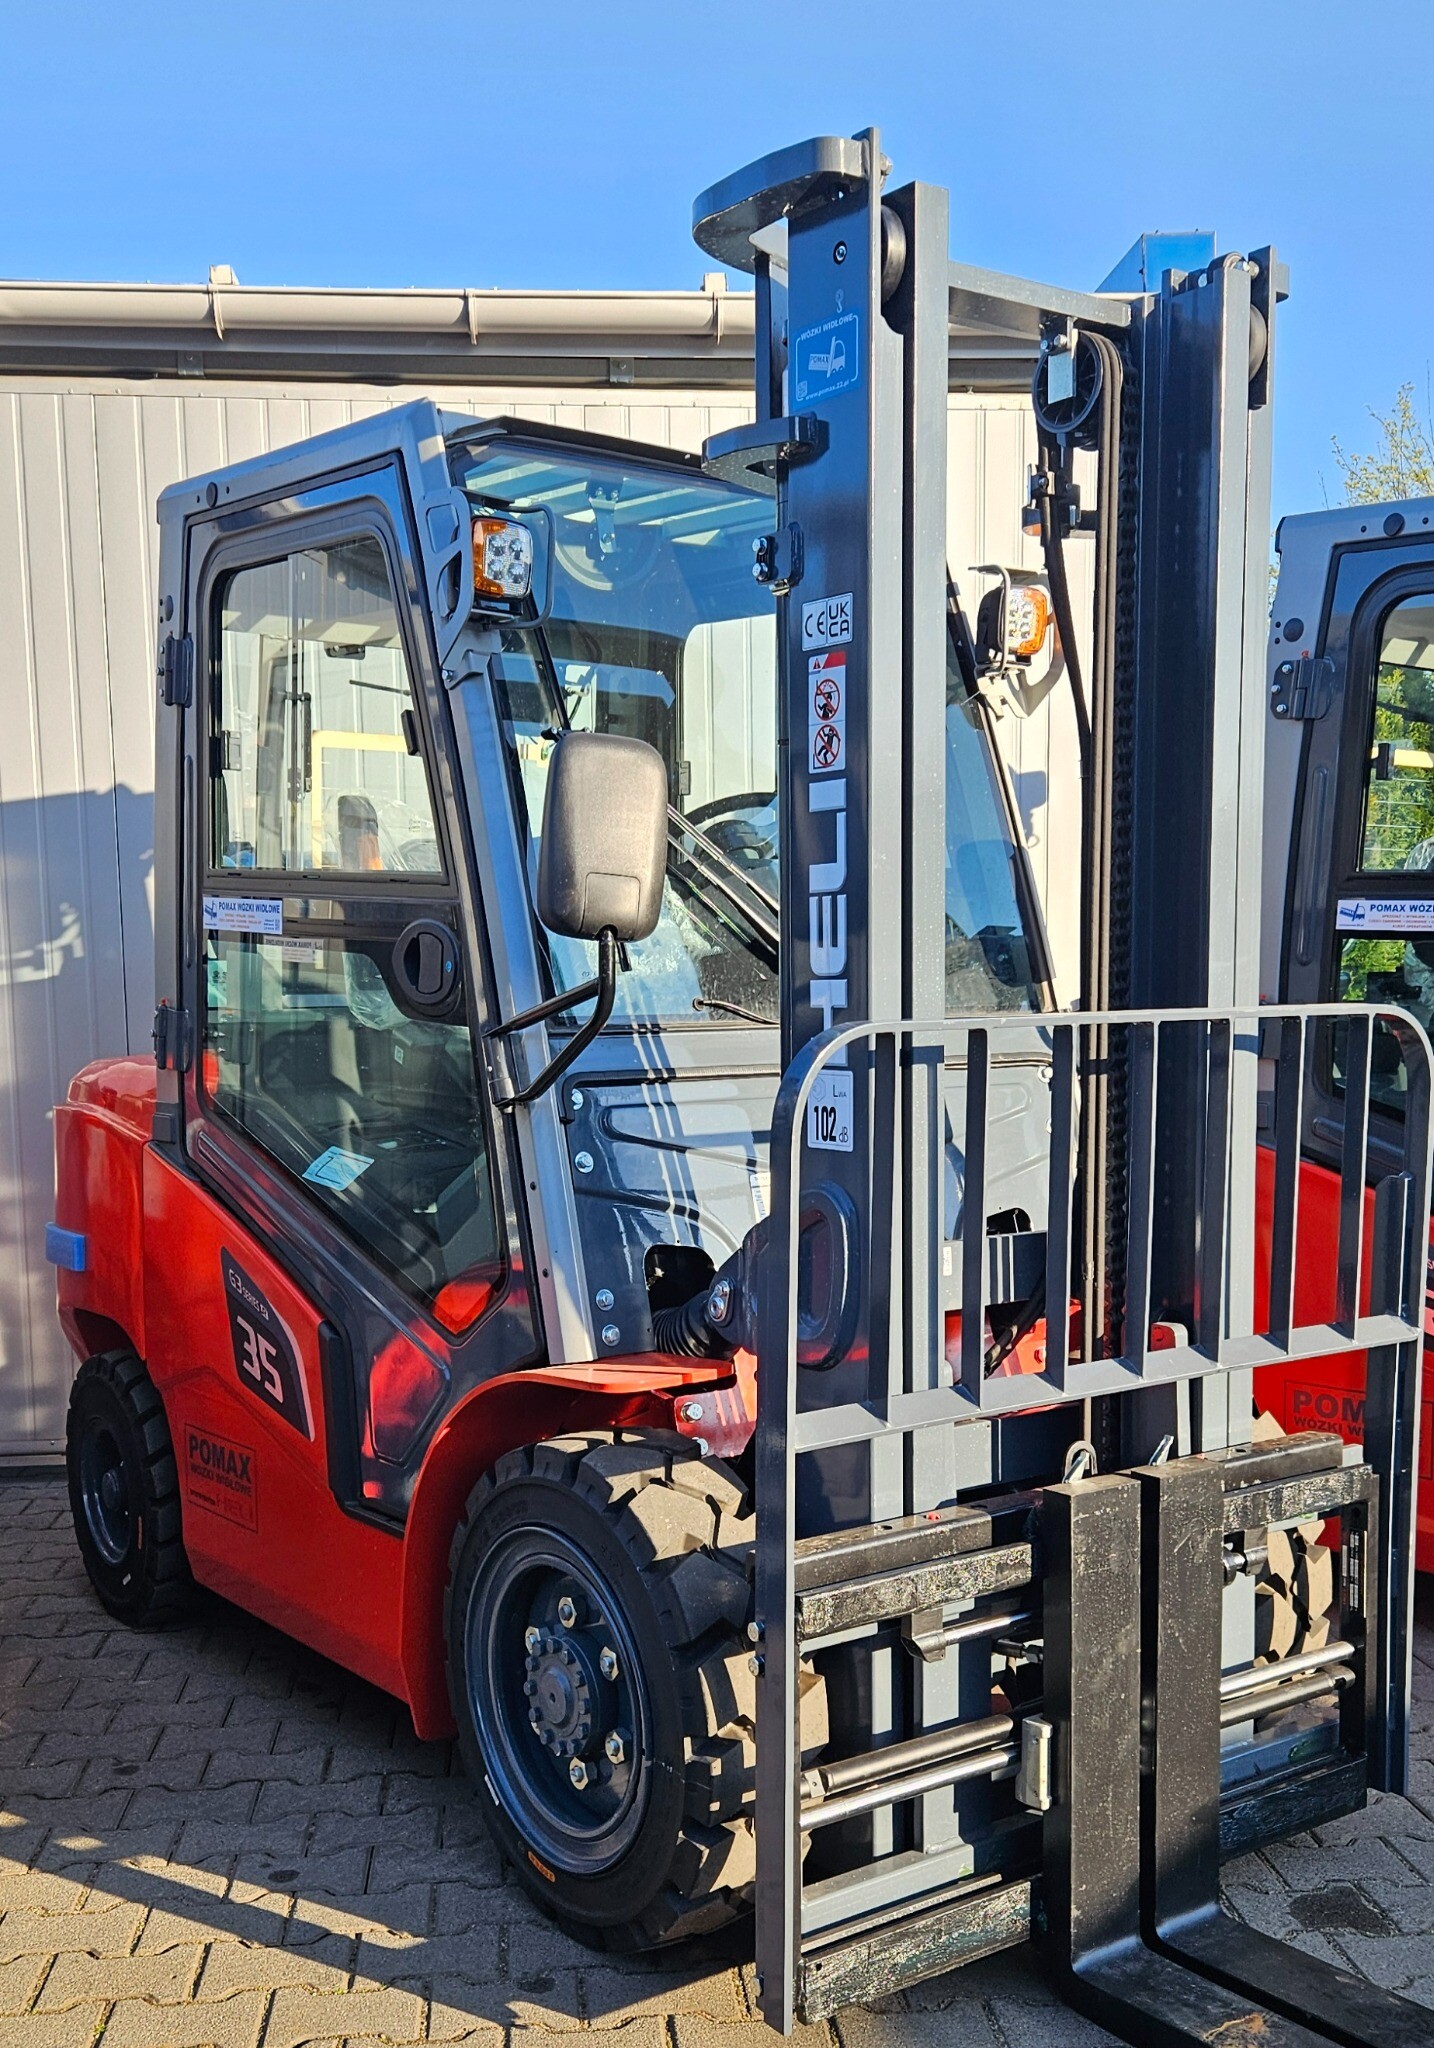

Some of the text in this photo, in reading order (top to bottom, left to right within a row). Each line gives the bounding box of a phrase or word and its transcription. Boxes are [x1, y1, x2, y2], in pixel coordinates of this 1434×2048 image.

[800, 312, 854, 341] WÓZKI WIDŁOWE
[810, 354, 829, 364] POMAX
[804, 611, 826, 638] CE
[828, 601, 850, 620] UK
[828, 619, 850, 637] CA
[218, 901, 237, 910] POMAX
[255, 904, 280, 914] WIDŁOWE
[1370, 903, 1406, 912] POMAX
[808, 778, 848, 1066] HELI
[814, 1105, 849, 1143] 102 dB
[236, 1315, 284, 1404] 35
[1293, 1388, 1366, 1424] POM
[188, 1434, 252, 1485] POMAX
